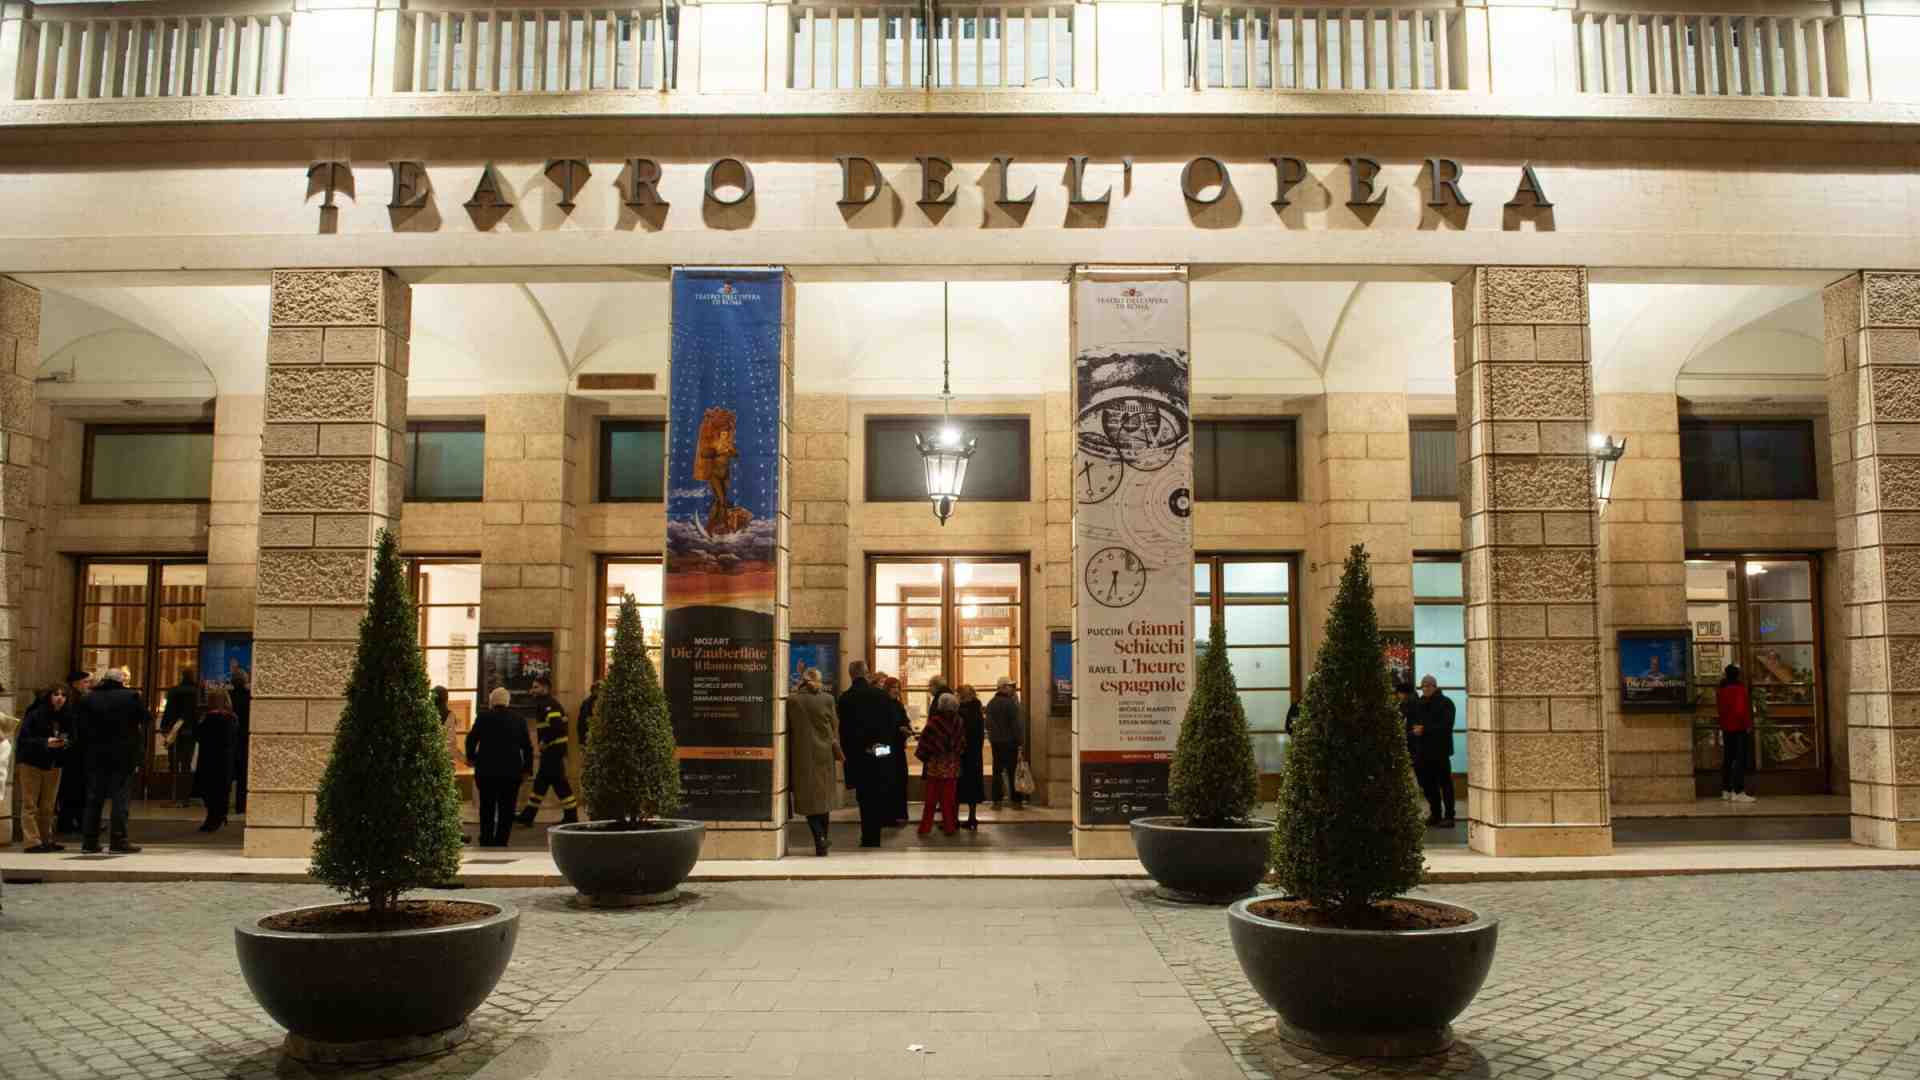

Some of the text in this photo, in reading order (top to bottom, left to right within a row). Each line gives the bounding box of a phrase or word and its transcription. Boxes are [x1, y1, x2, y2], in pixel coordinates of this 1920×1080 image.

[305, 156, 1555, 208] TEATRO DELL'OPERA
[1088, 619, 1185, 637] PUCCINI Gianni
[694, 637, 729, 645] MOZART
[1113, 638, 1185, 654] Schicchi
[1088, 665, 1119, 674] RAVEL
[1099, 676, 1185, 696] espagnole
